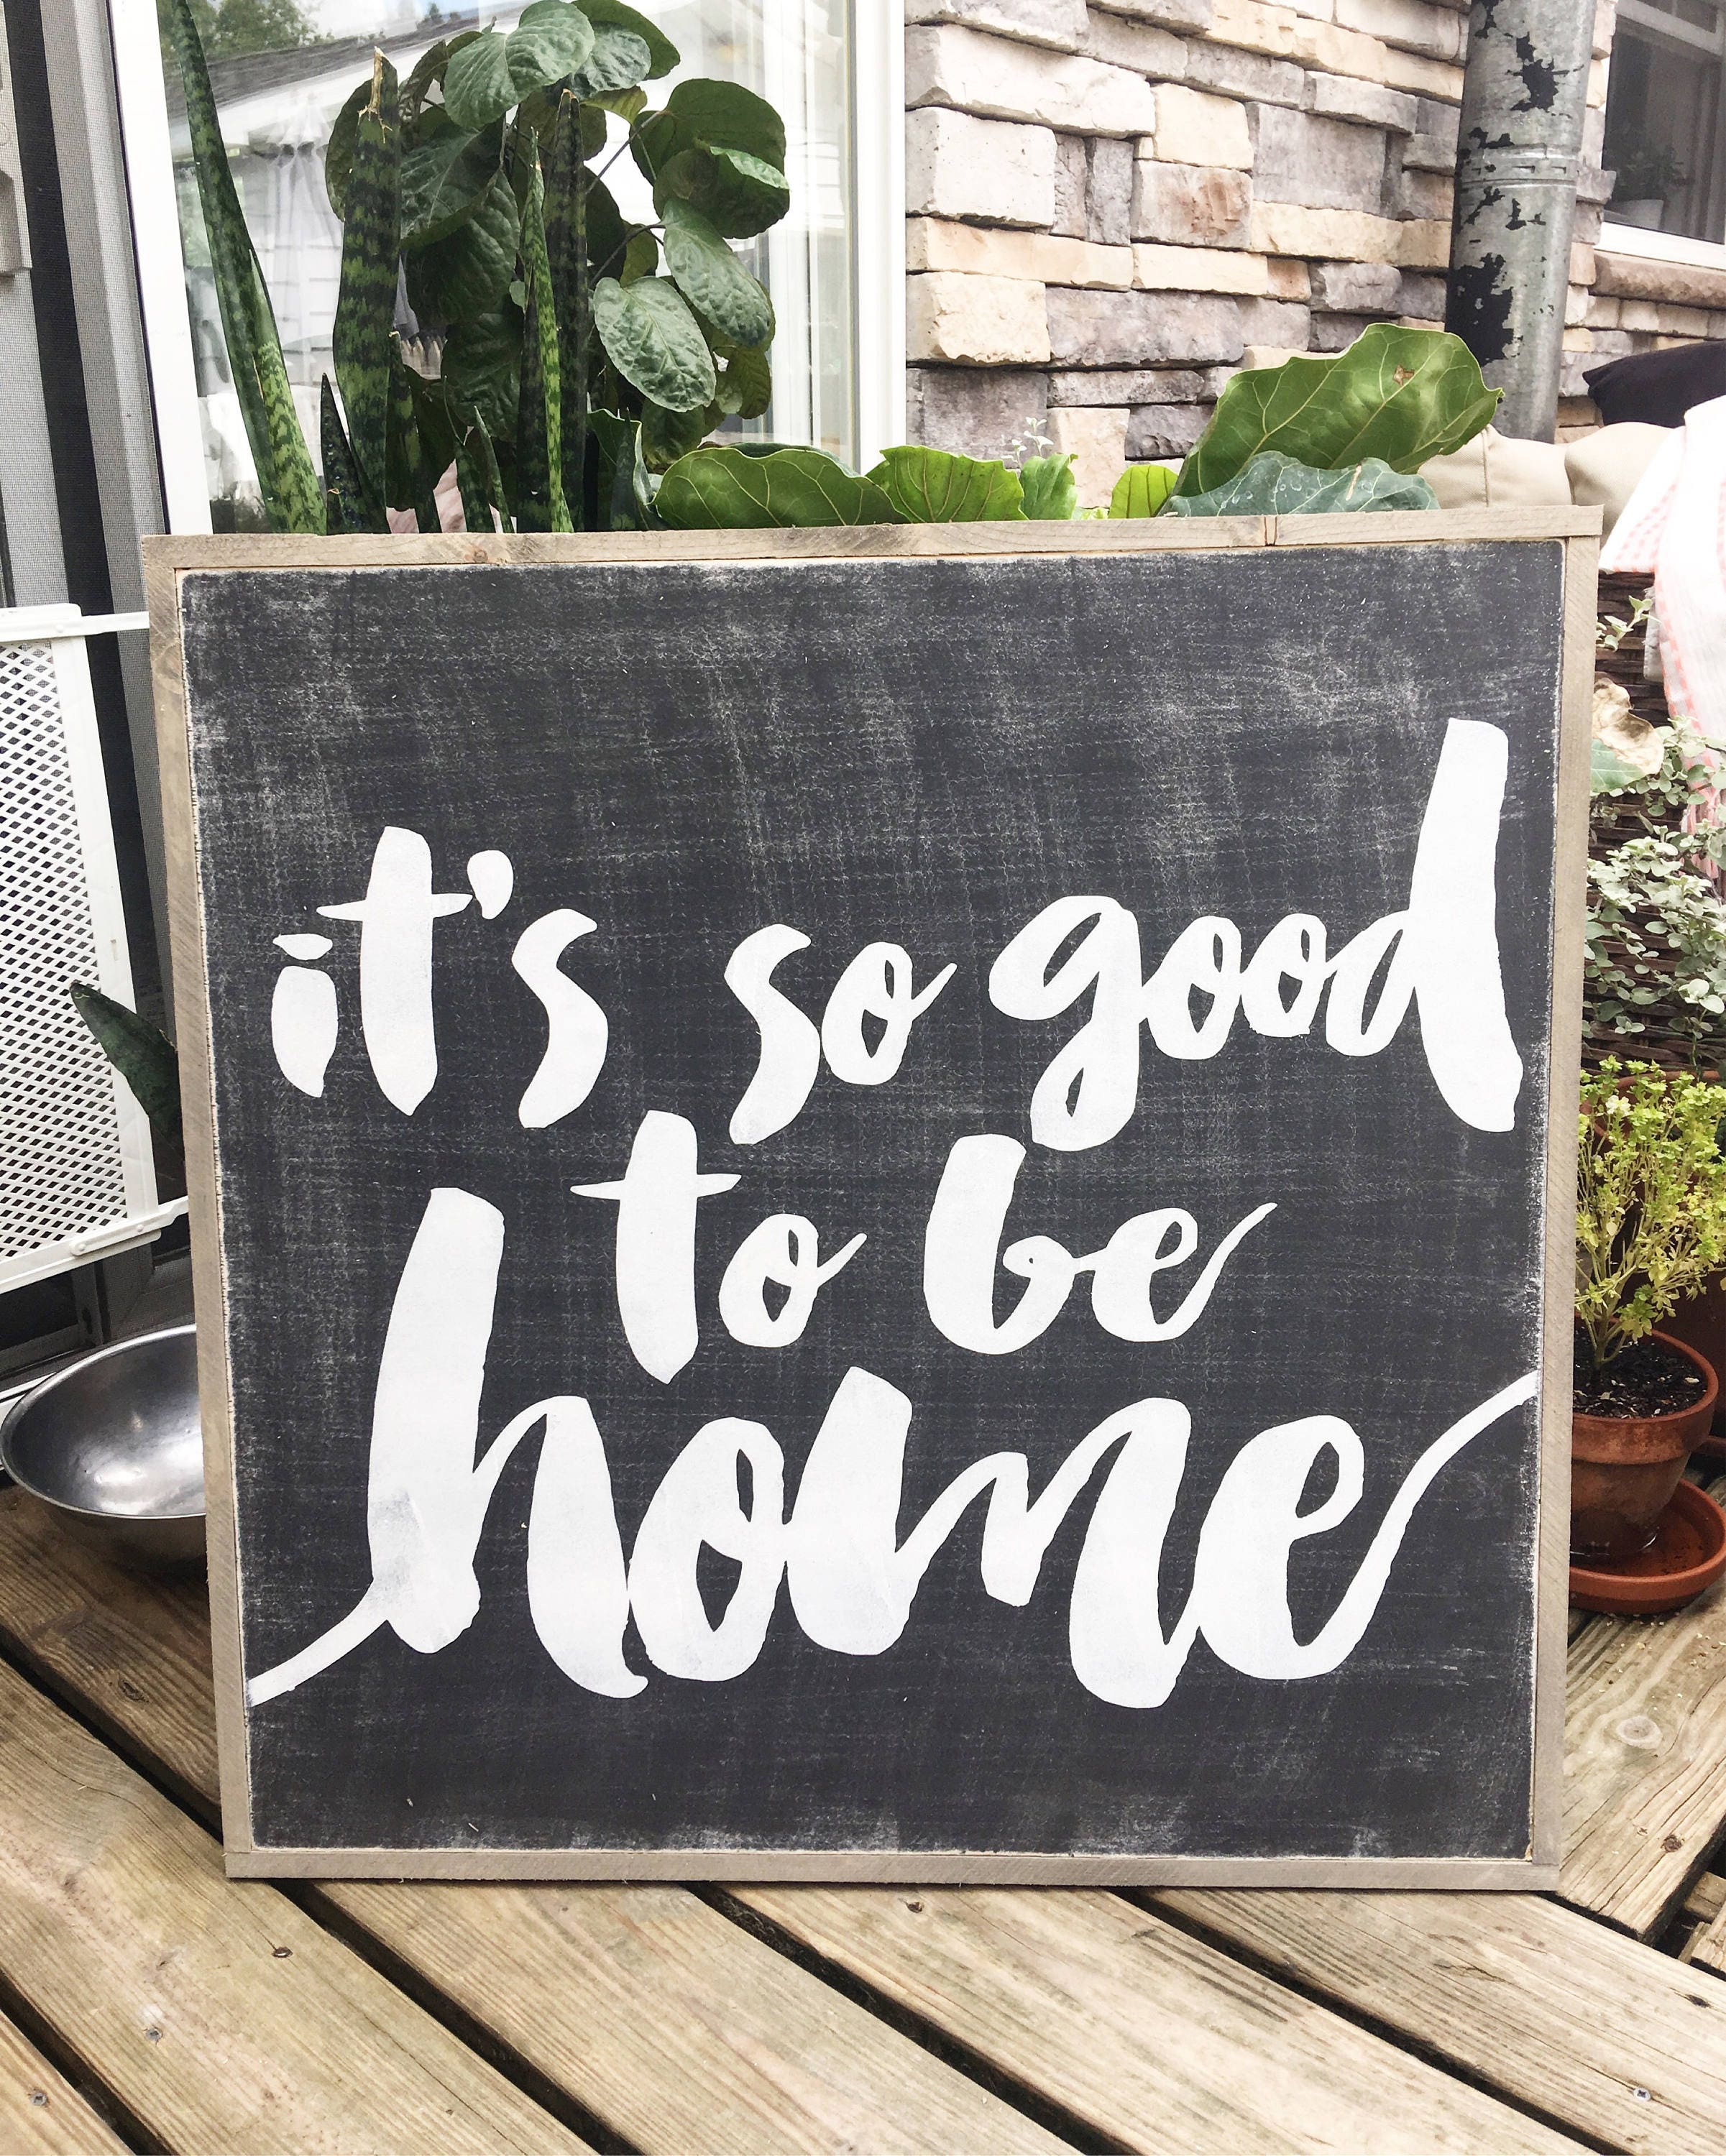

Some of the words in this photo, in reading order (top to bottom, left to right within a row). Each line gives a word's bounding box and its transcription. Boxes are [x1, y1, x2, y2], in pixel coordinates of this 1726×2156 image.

[272, 826, 610, 1129] it's
[724, 923, 958, 1145] so
[988, 717, 1524, 1152] good
[249, 1187, 1537, 1709] home
[571, 1110, 868, 1384] to
[923, 1133, 1277, 1355] be
